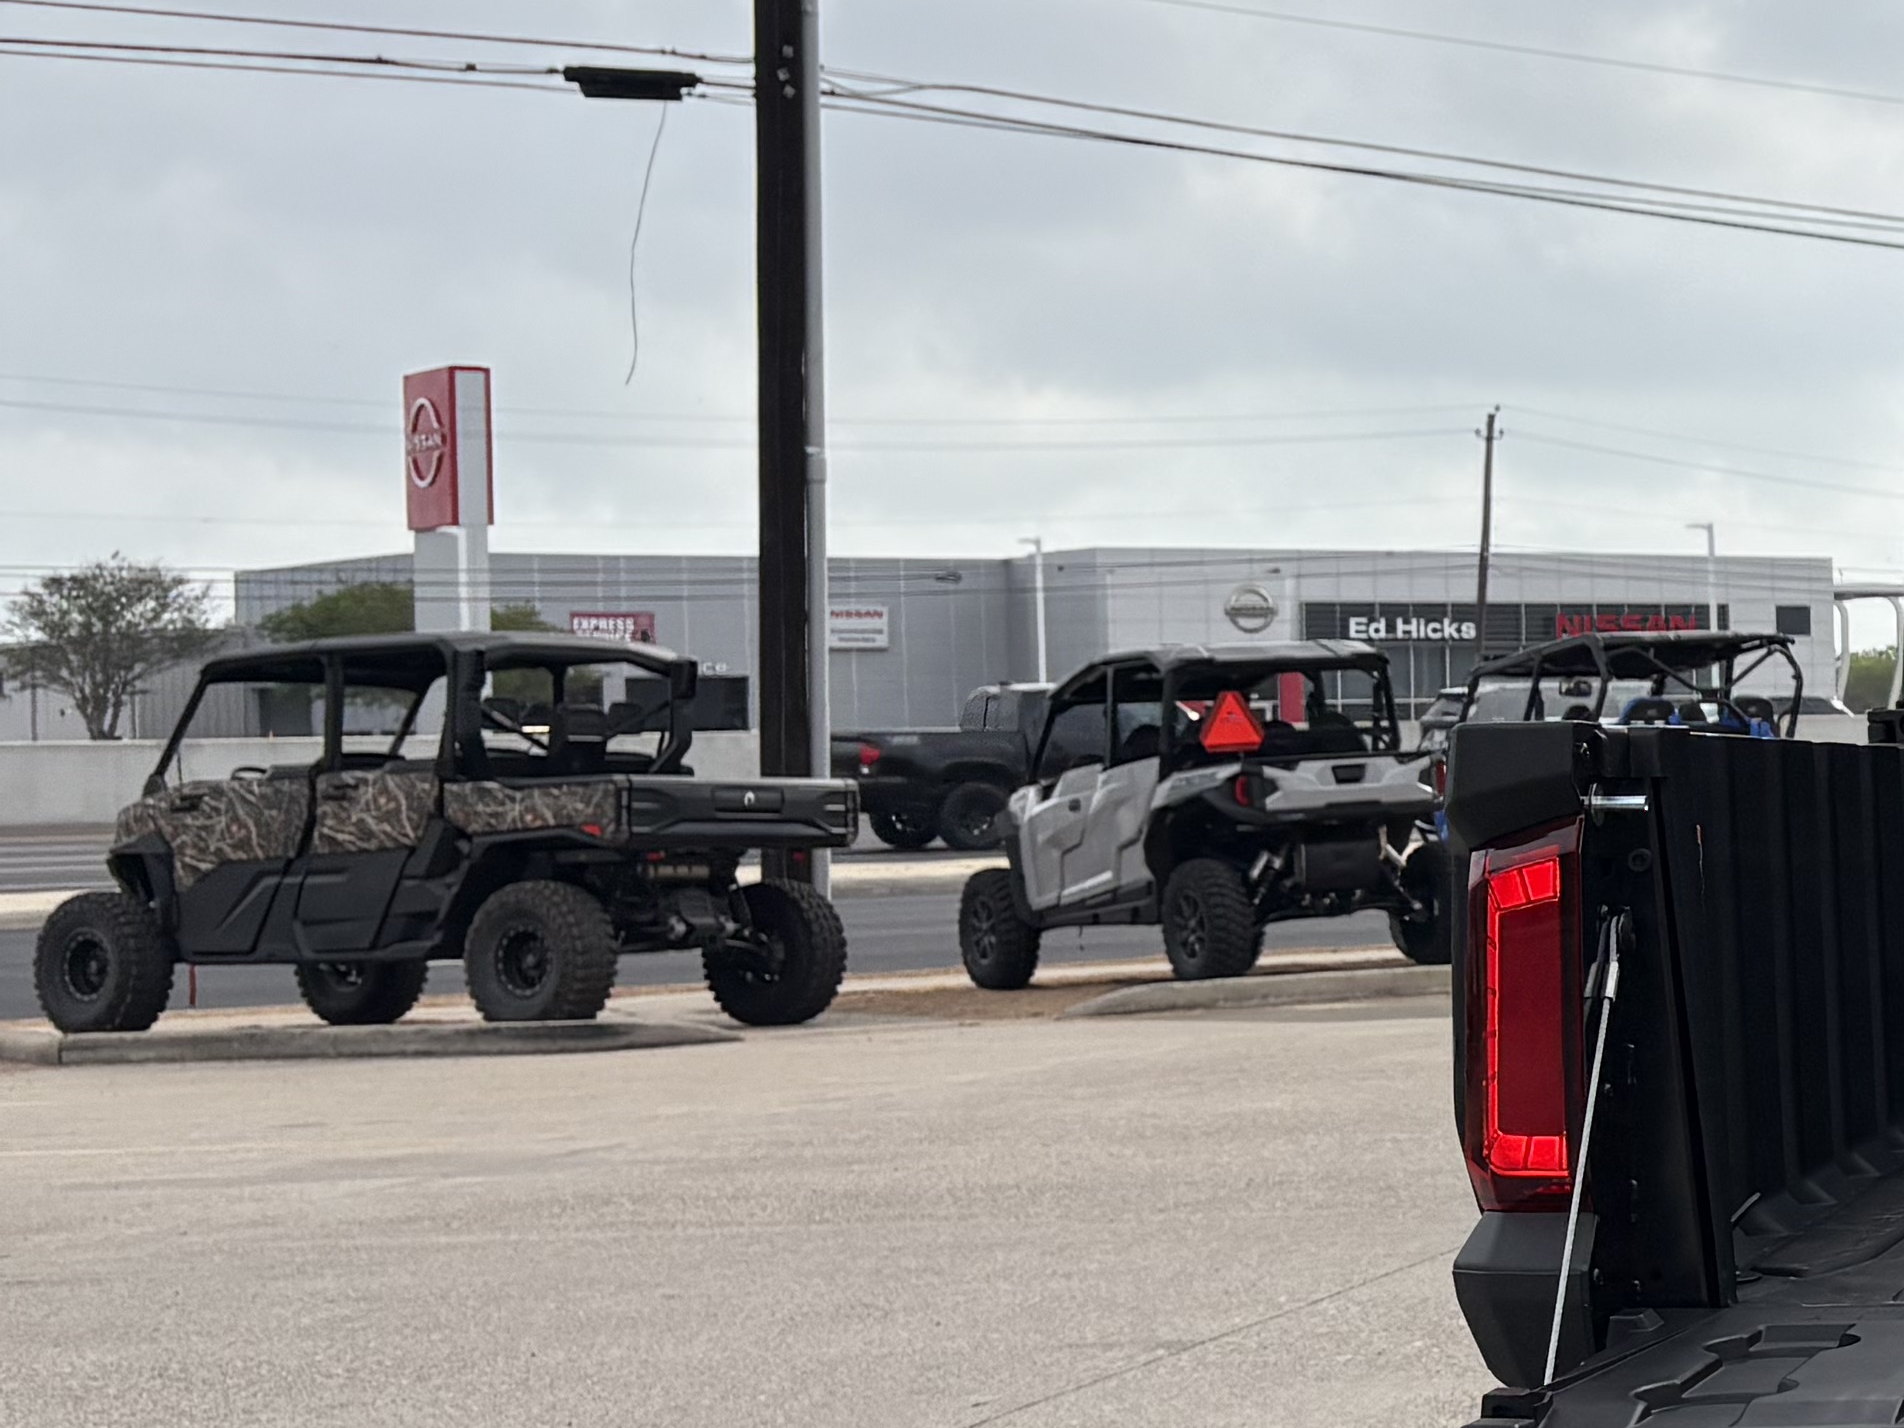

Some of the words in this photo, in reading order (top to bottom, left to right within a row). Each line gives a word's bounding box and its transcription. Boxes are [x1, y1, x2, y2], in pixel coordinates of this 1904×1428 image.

[573, 616, 635, 632] EXPRESS
[1349, 616, 1386, 640] Ed
[1396, 617, 1477, 640] Hicks
[1556, 612, 1696, 640] NISSAN
